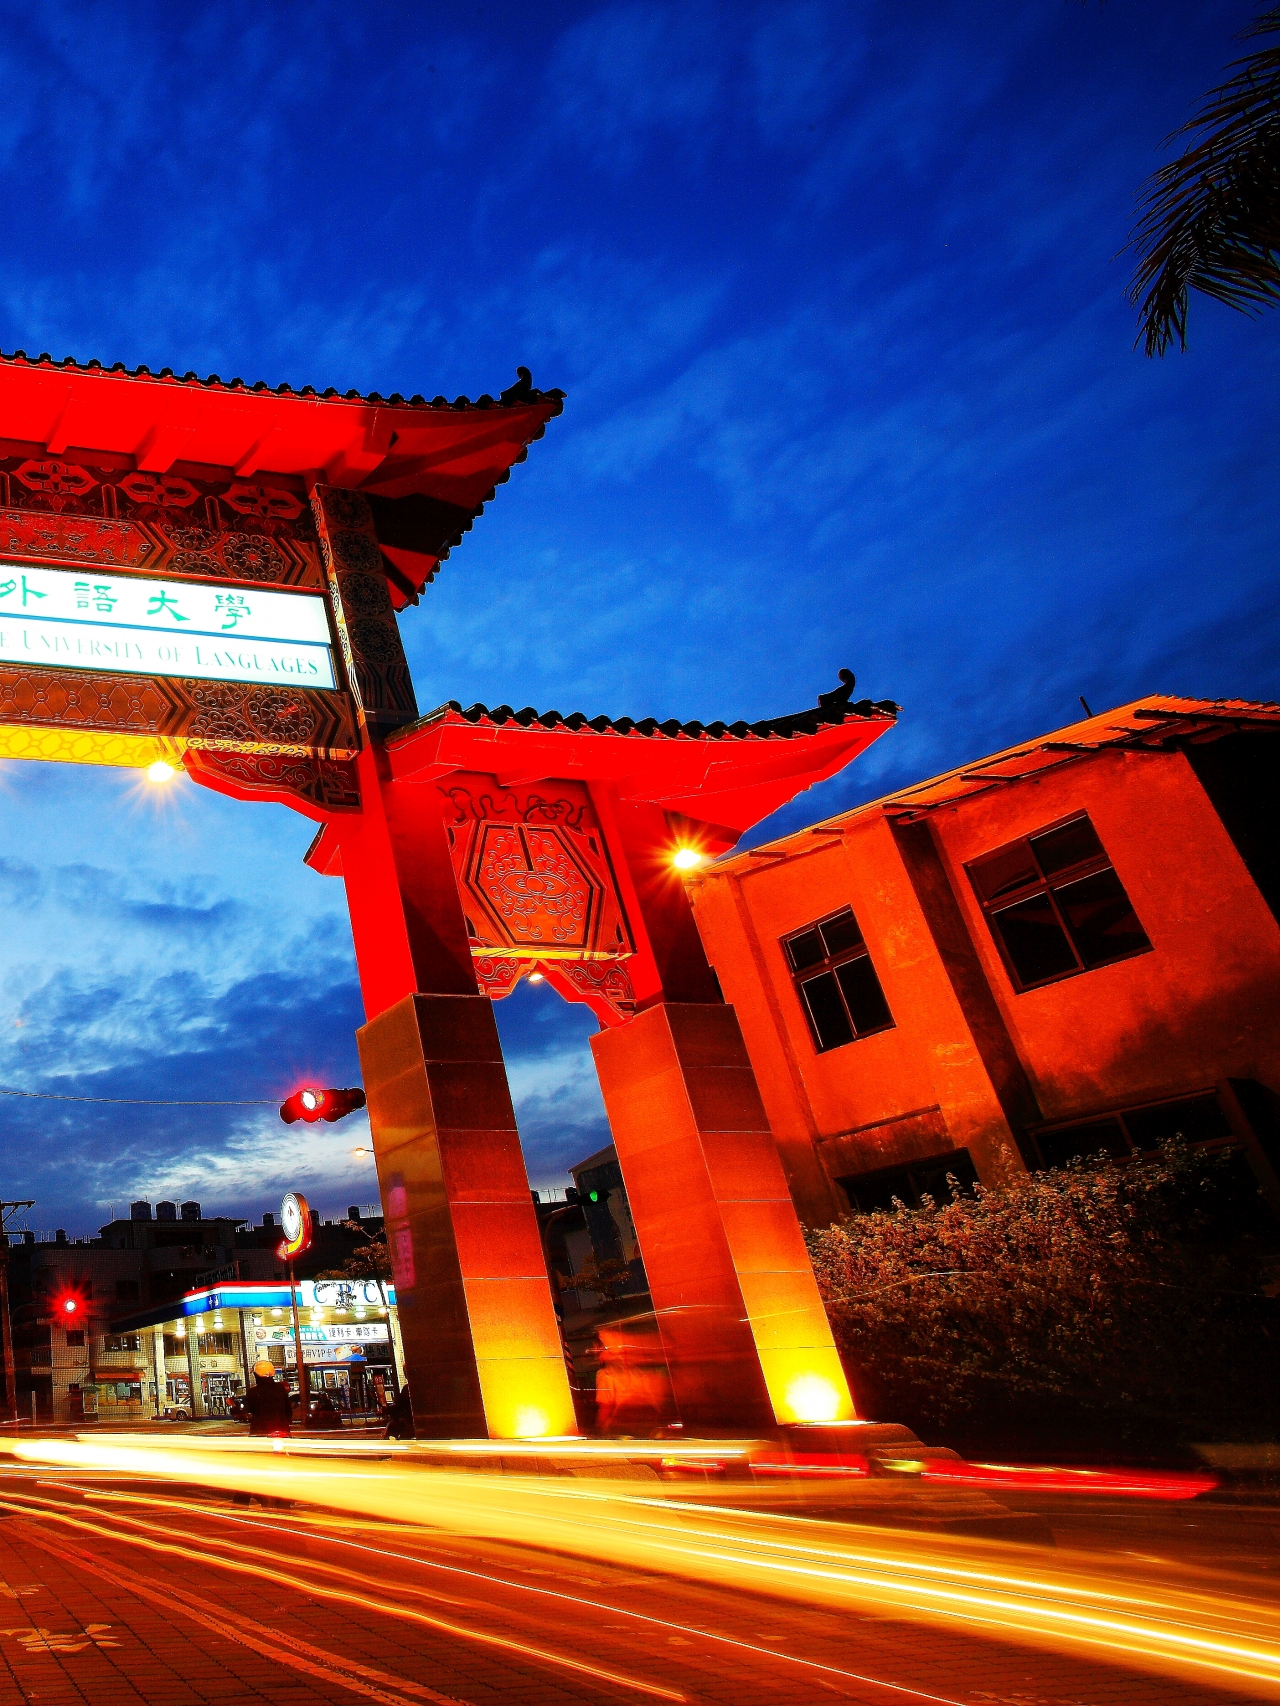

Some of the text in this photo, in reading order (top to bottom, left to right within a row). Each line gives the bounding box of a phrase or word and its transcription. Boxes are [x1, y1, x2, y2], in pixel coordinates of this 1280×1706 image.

[22, 630, 144, 660] UNIVERSITY
[195, 646, 318, 676] LANGUAGES
[313, 1282, 378, 1304] CPC
